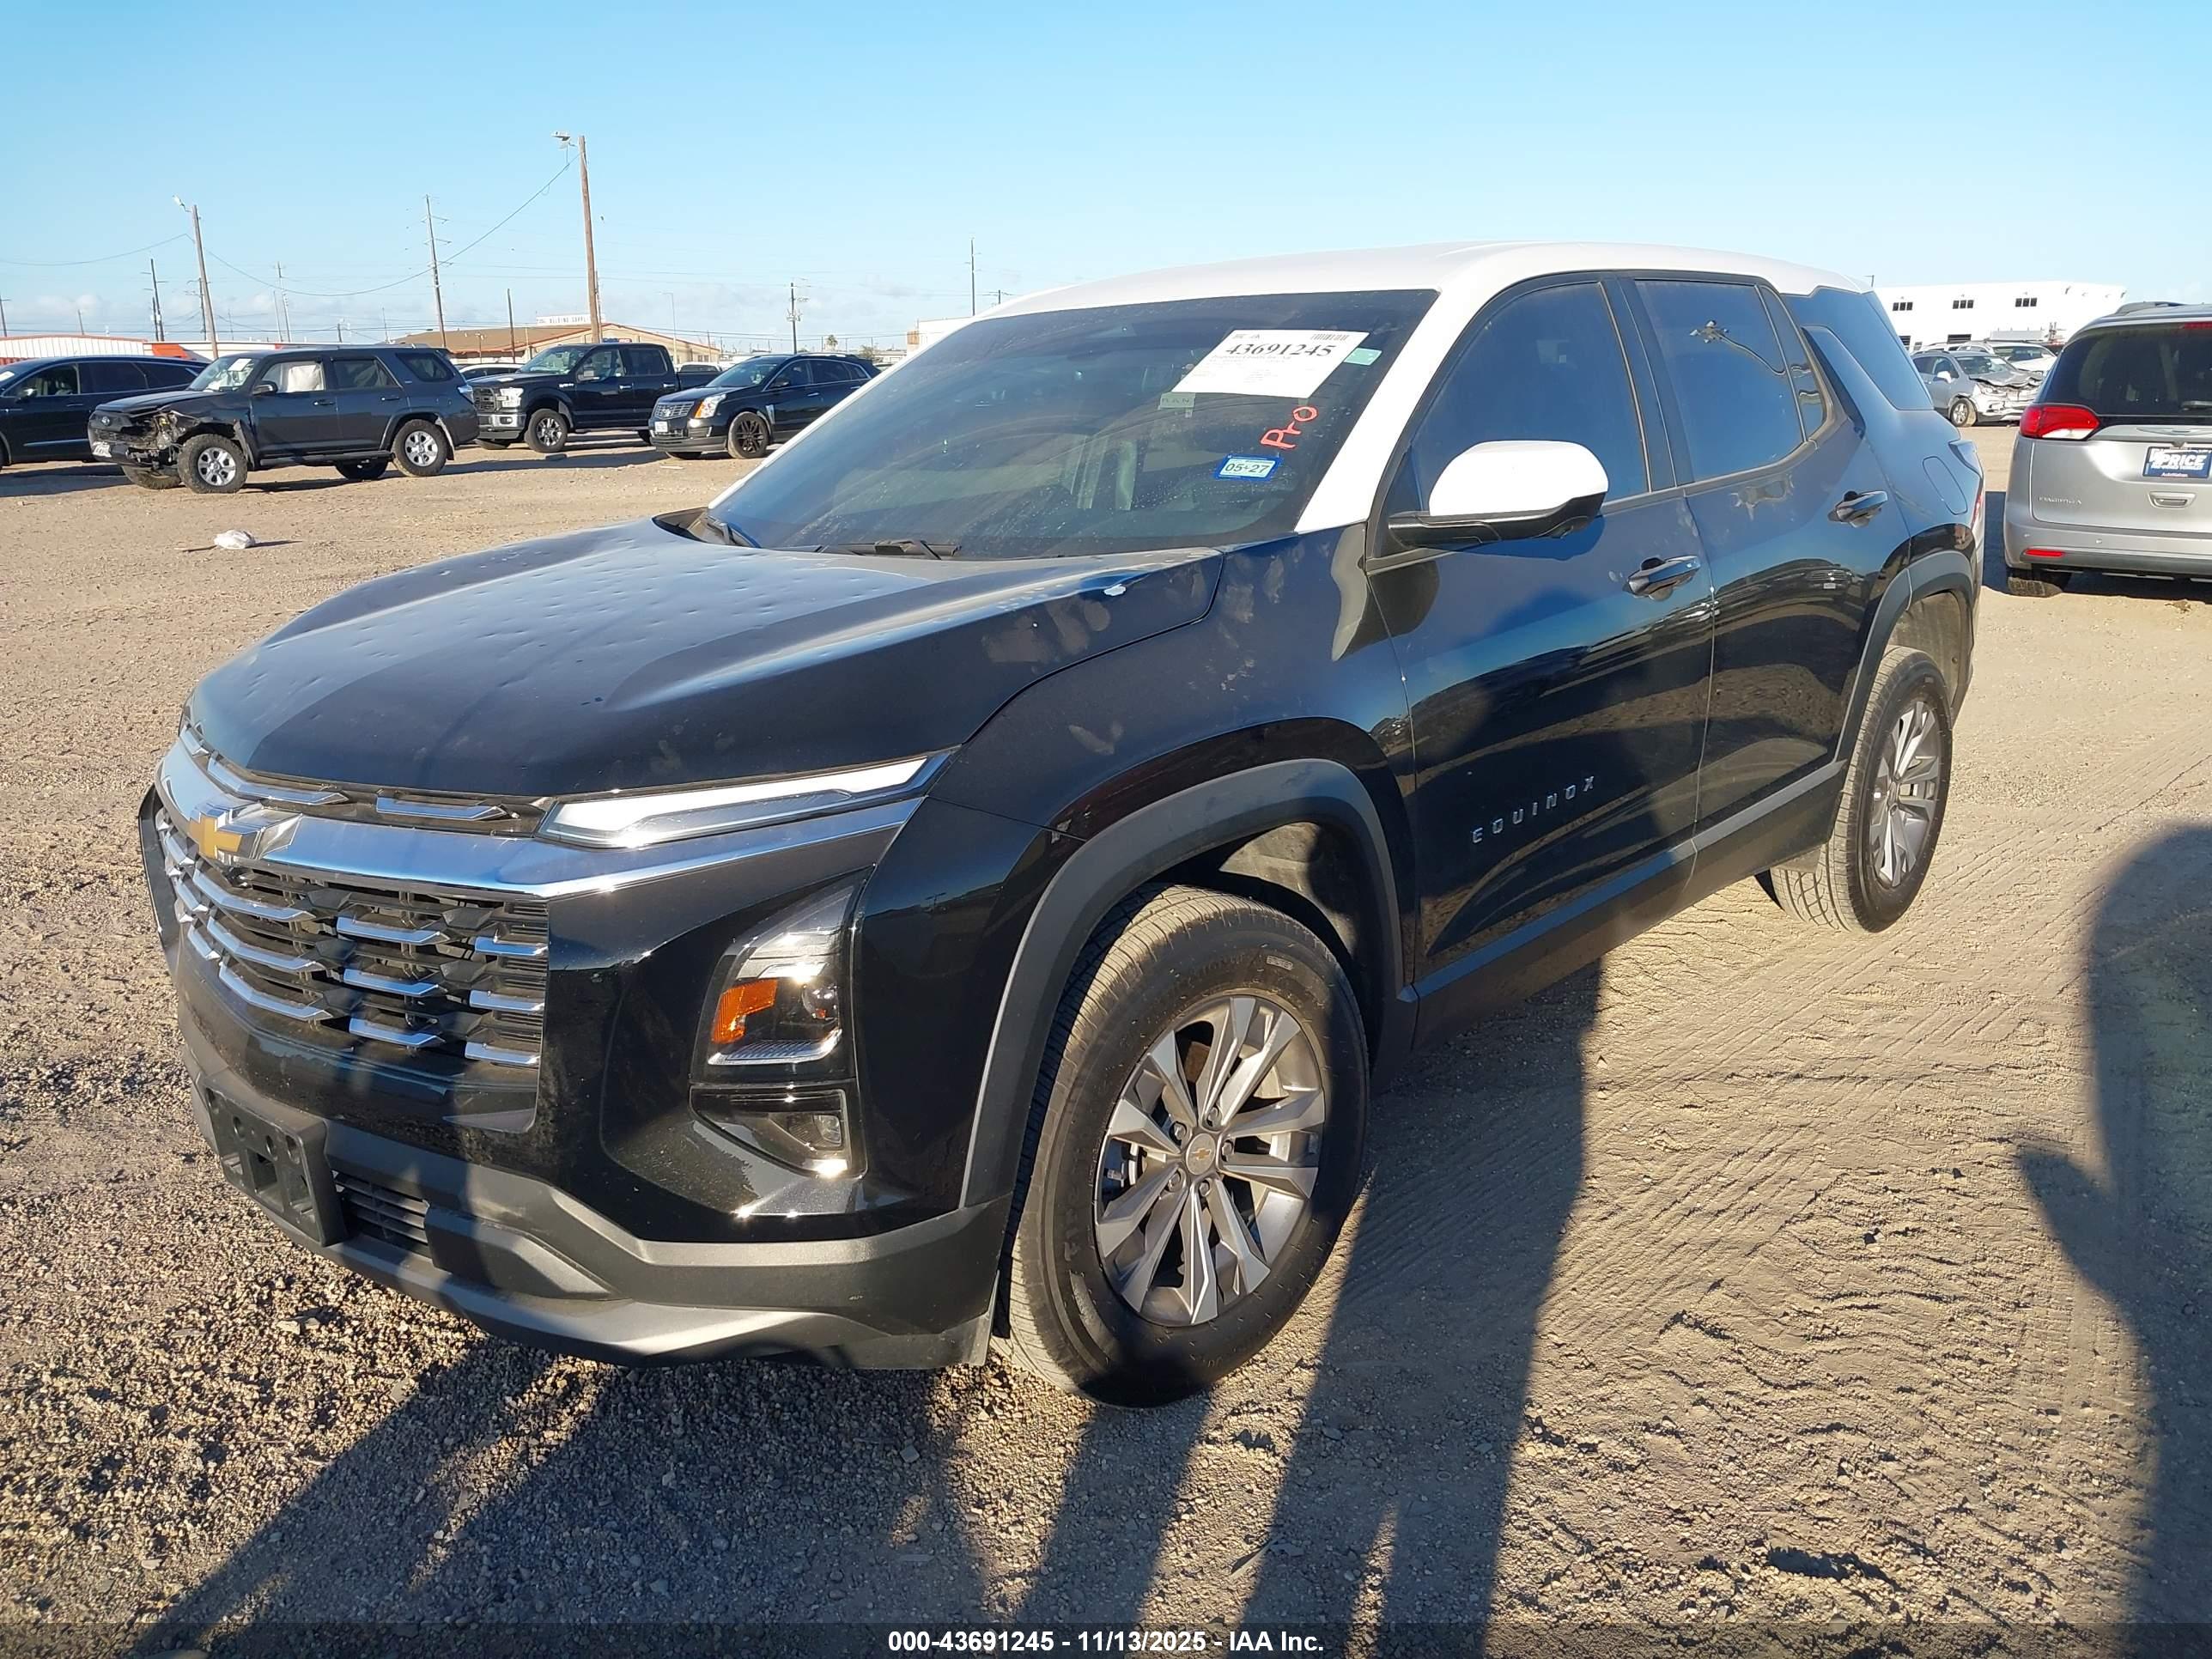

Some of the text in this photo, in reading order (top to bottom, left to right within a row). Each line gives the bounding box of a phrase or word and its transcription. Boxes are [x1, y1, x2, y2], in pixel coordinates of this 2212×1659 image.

[1225, 343, 1336, 356] 43691245
[1260, 406, 1317, 448] Pro
[1472, 775, 1595, 843] EQUINOX
